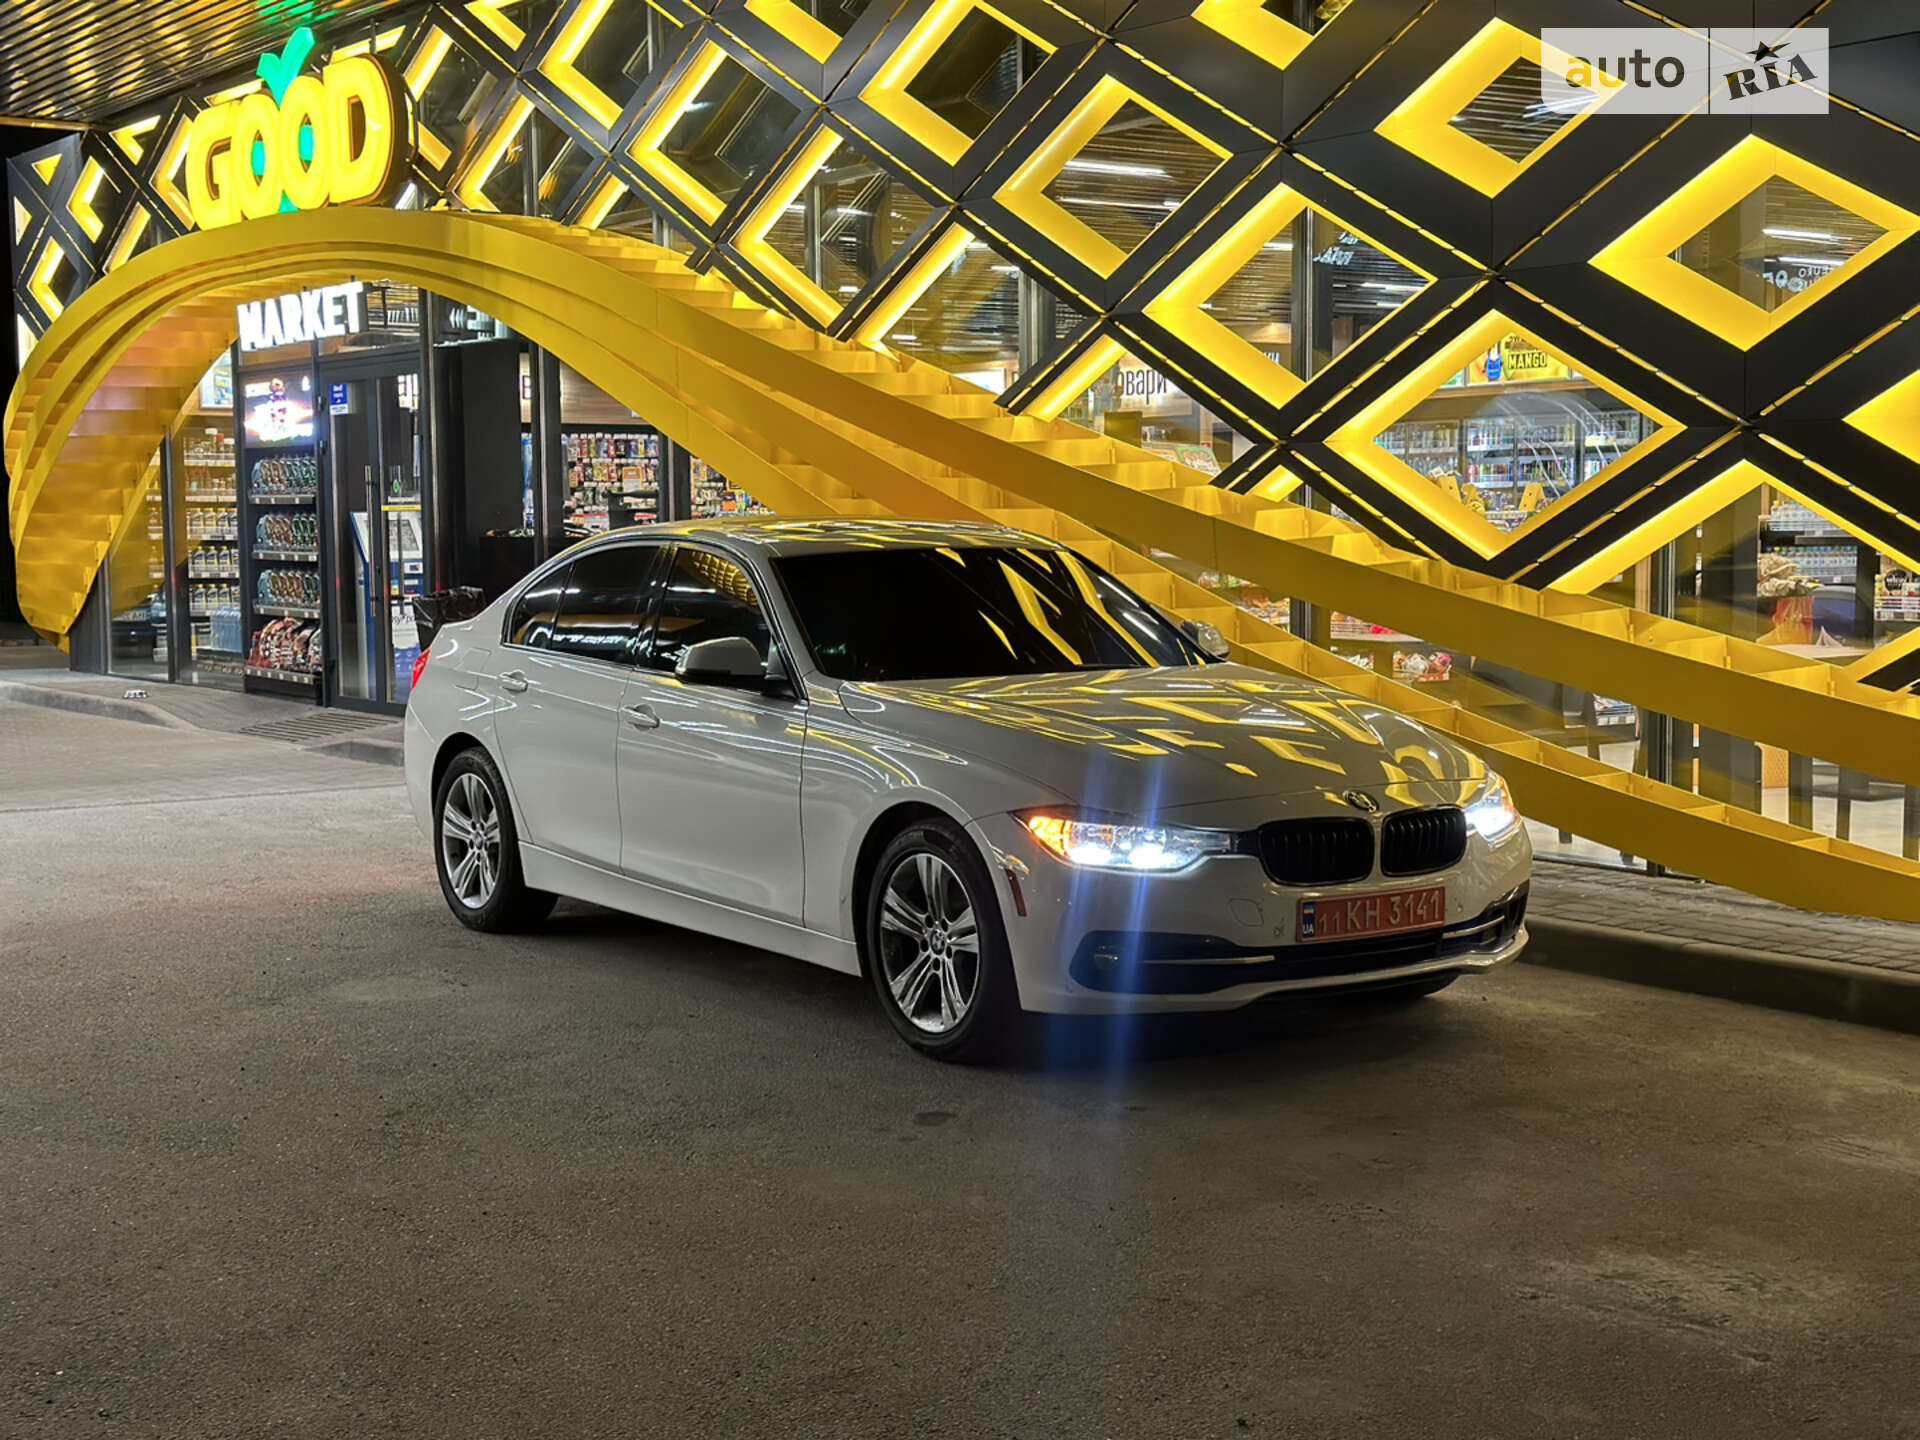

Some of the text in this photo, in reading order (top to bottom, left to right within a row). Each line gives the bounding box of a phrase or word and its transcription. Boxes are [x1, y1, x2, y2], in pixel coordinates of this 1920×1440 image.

[185, 56, 396, 231] GOOD
[237, 281, 364, 352] MARKET
[1508, 351, 1548, 369] MANGO
[1388, 889, 1440, 925] 3141
